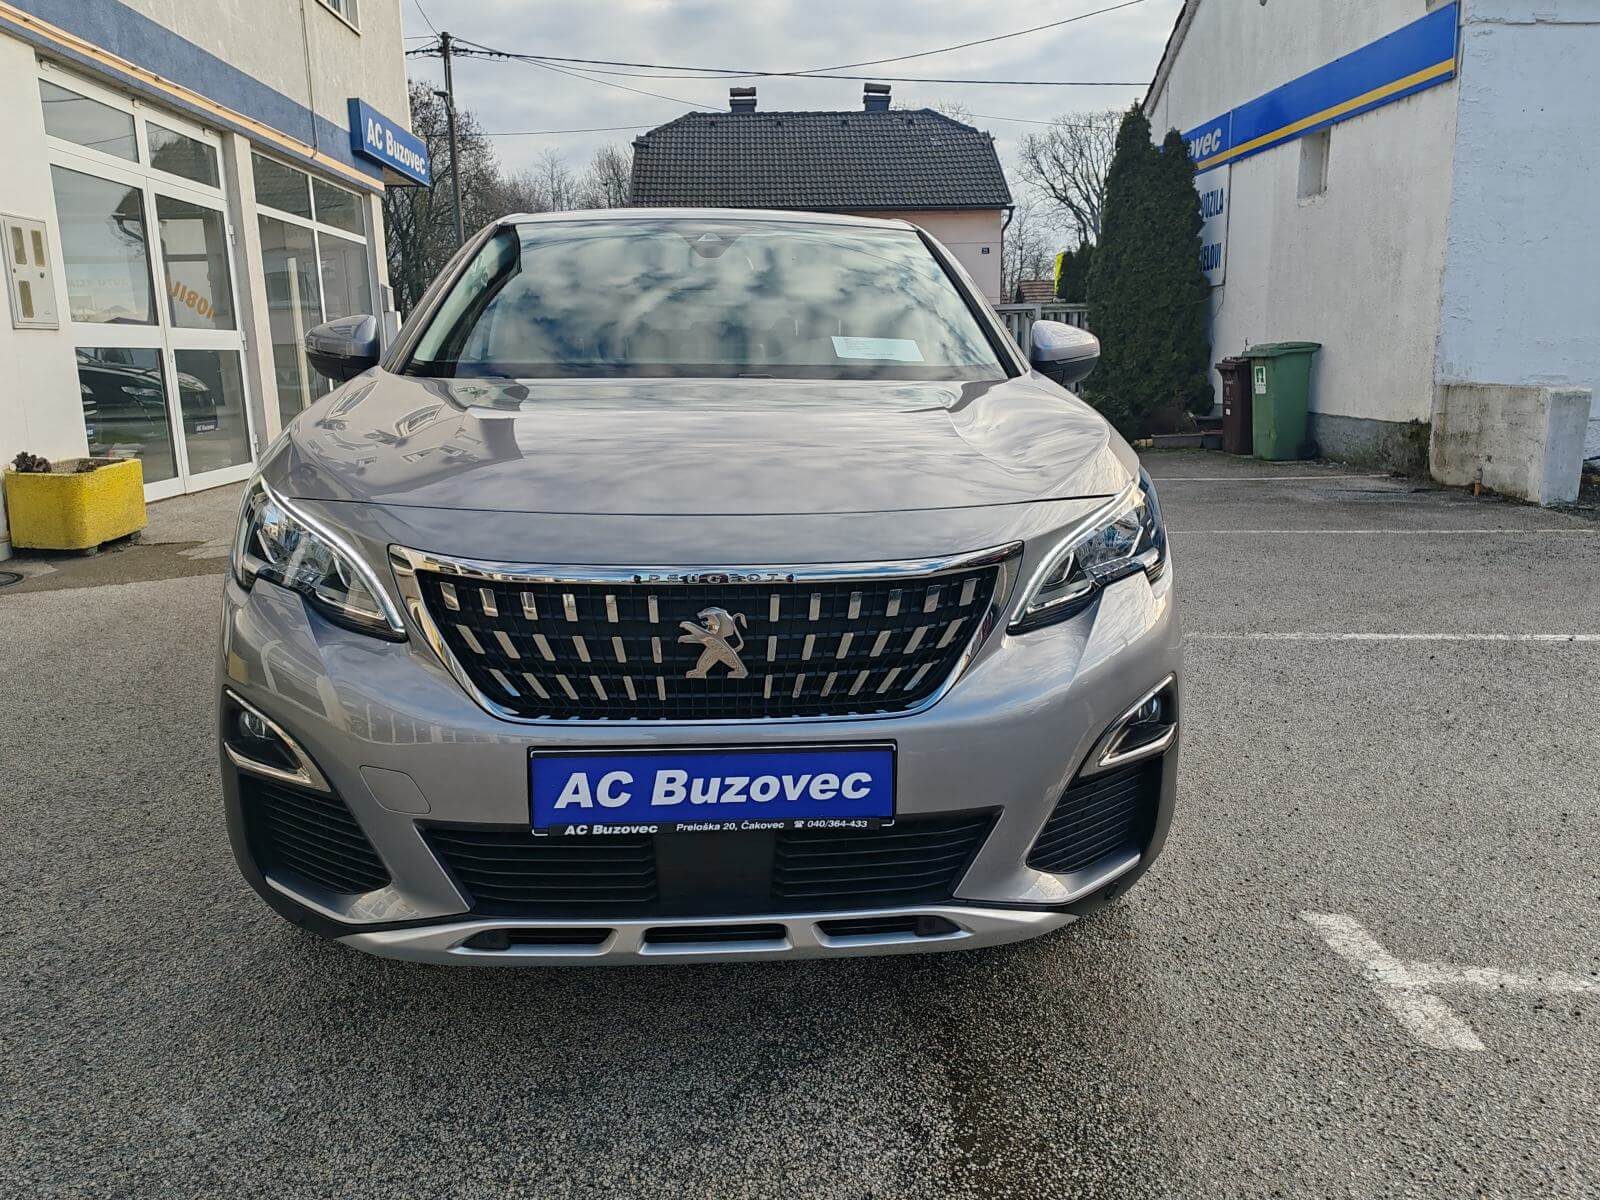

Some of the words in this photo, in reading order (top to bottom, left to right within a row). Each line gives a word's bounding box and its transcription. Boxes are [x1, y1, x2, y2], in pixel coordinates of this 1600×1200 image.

[367, 118, 383, 150] AC
[386, 129, 426, 175] Buzovec
[649, 573, 779, 585] PEUGEOT
[554, 770, 634, 809] AC
[650, 769, 873, 807] Buzovec
[564, 825, 588, 836] AC
[592, 823, 659, 835] Buzovec
[676, 820, 721, 832] Preloška
[723, 822, 739, 832] 20,
[741, 819, 785, 831] Čakovec
[807, 820, 868, 829] 040/364-433
